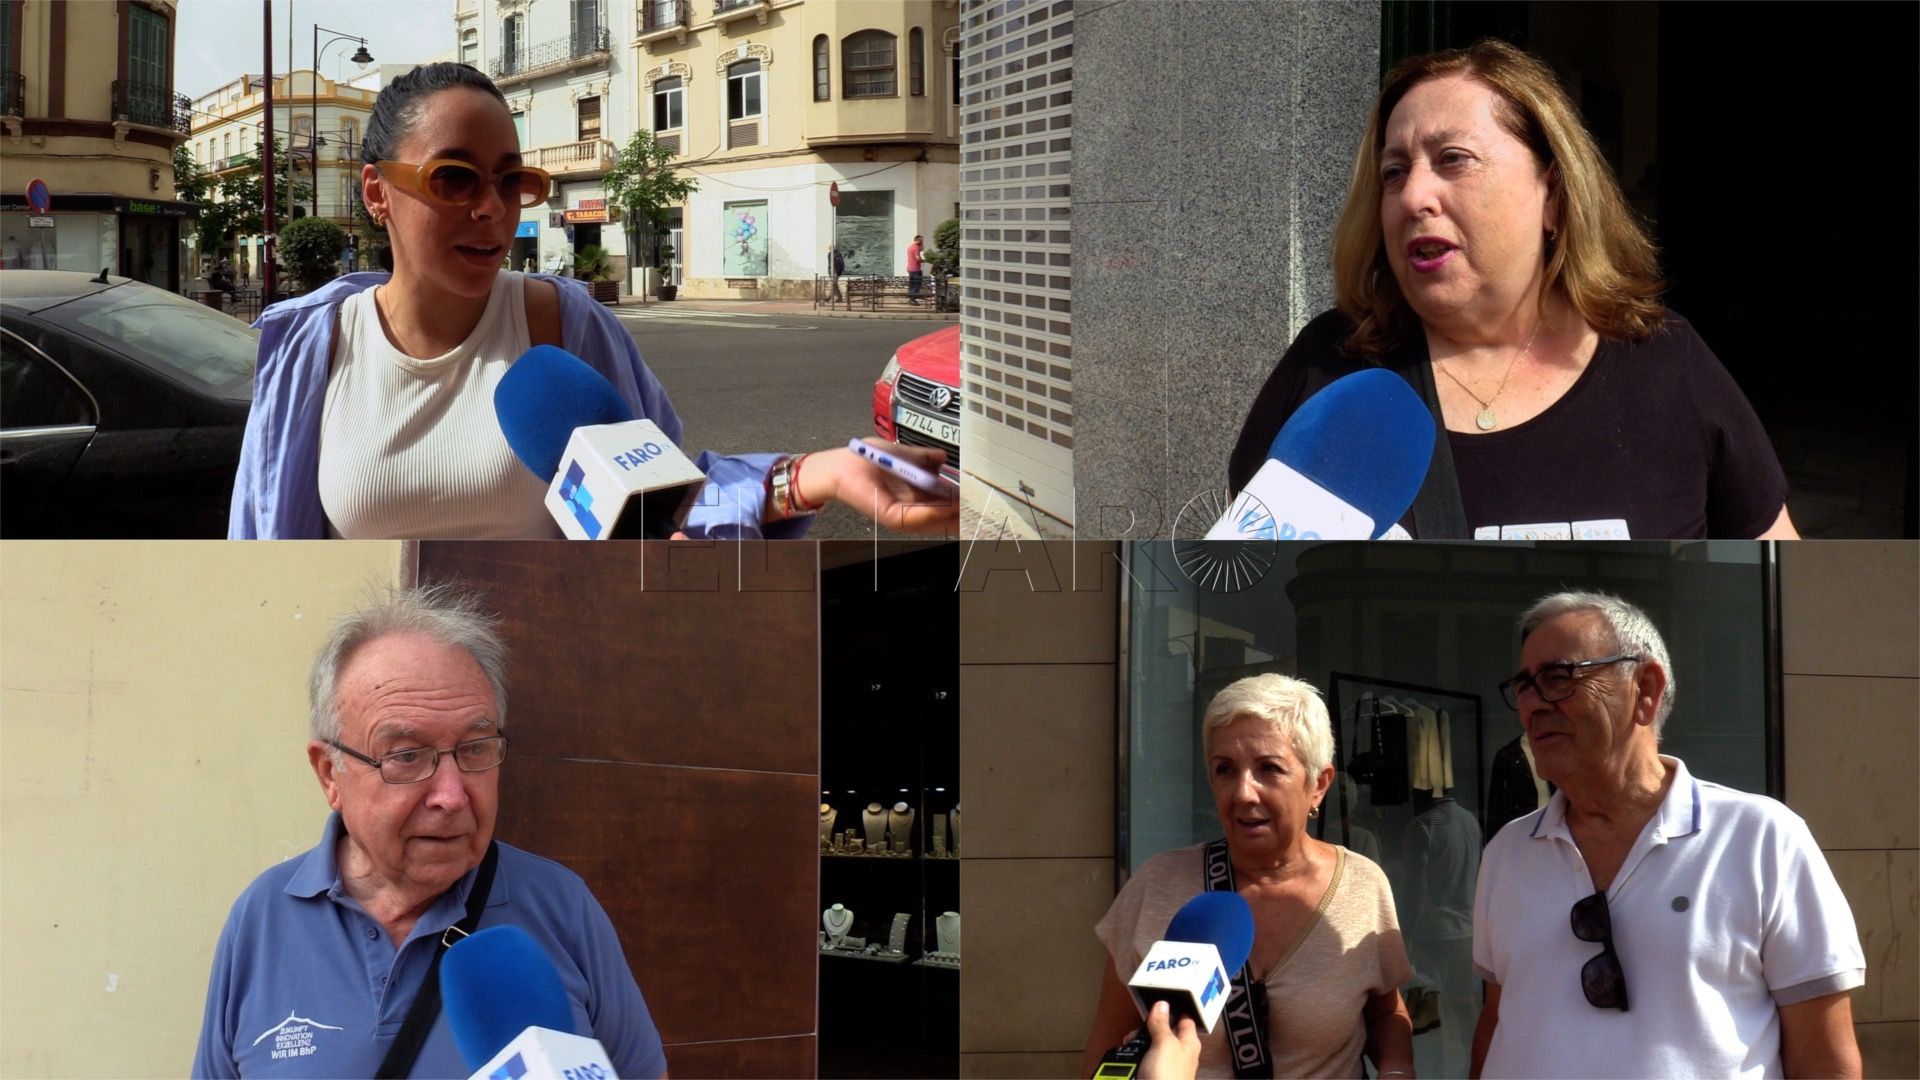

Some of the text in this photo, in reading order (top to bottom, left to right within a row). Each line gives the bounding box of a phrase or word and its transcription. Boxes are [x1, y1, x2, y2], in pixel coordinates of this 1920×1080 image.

[905, 410, 960, 446] 7744 GY
[613, 442, 662, 471] FARO
[1146, 957, 1191, 972] FARO
[275, 1031, 314, 1043] INNOVATION
[271, 1049, 287, 1060] WIR
[288, 1047, 299, 1058] IM
